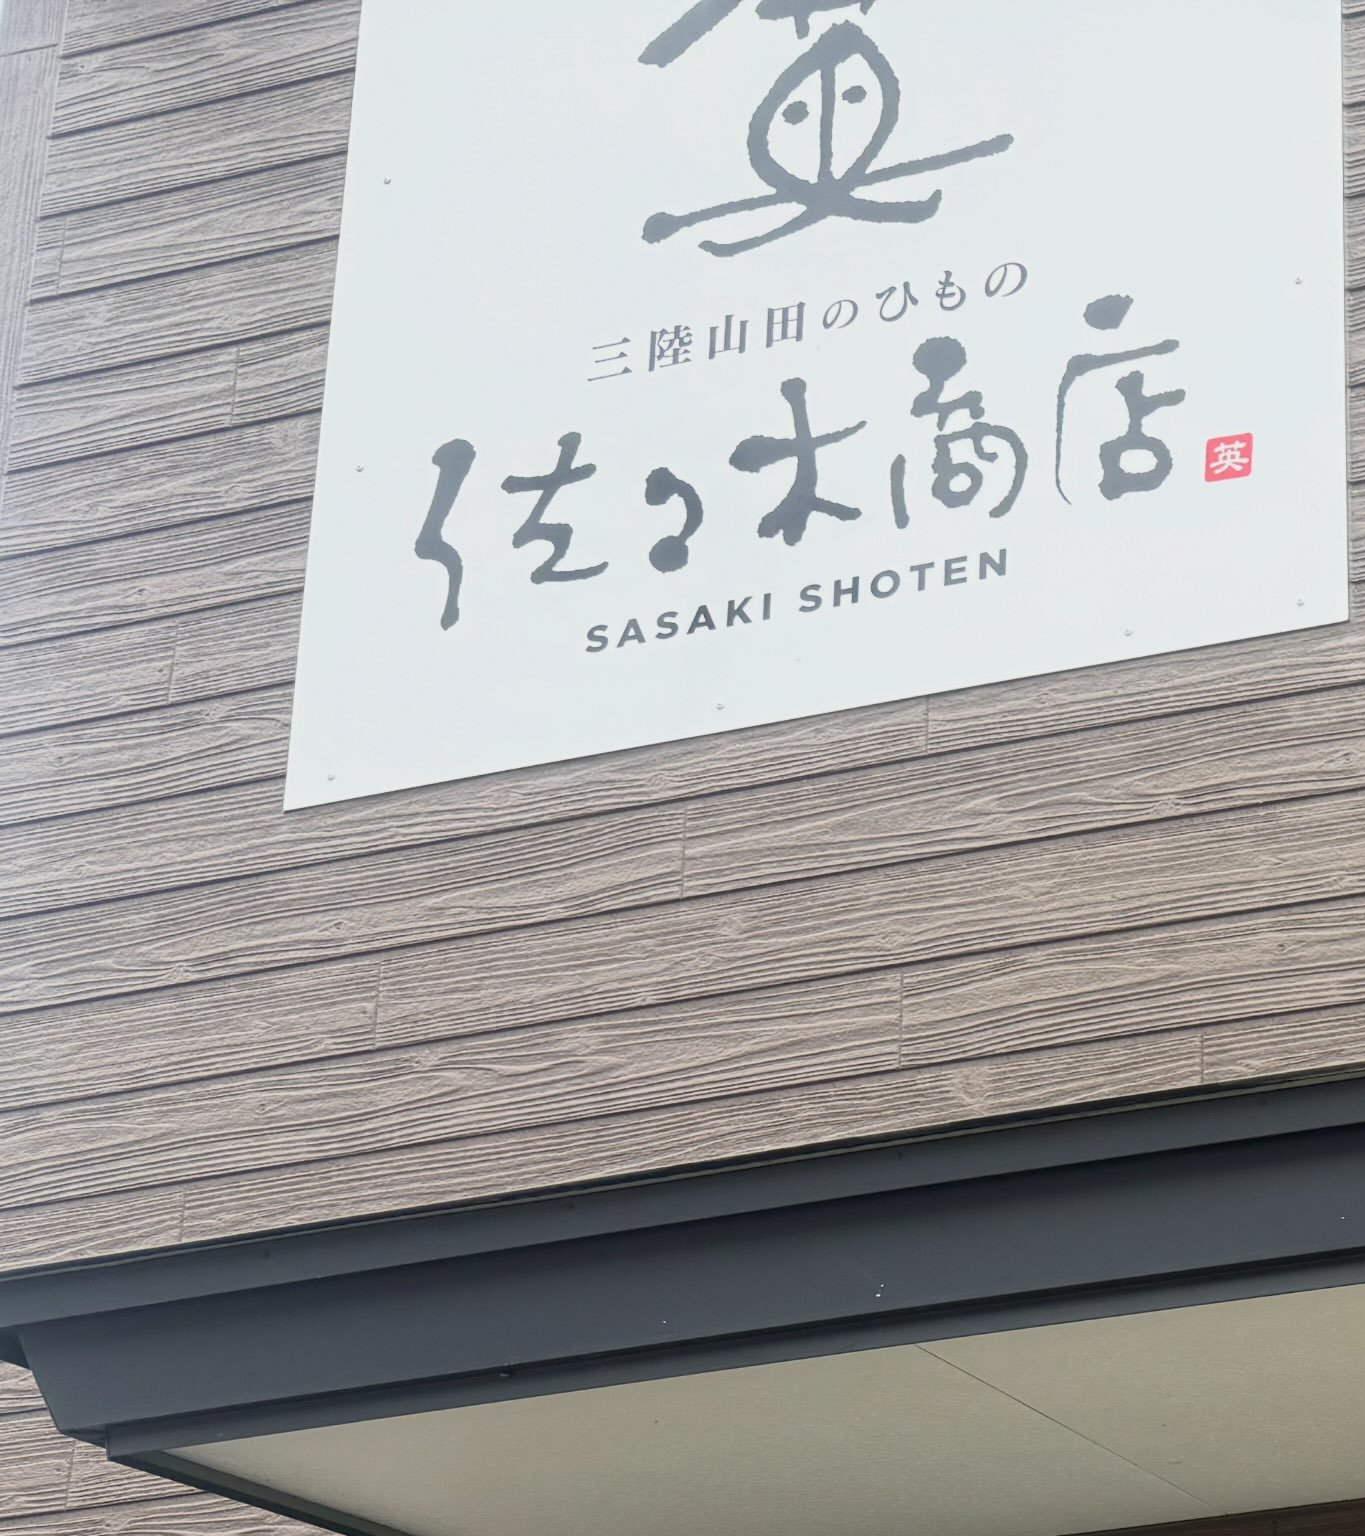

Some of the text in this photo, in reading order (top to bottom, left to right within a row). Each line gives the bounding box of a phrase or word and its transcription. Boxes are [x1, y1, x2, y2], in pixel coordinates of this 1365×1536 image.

[586, 259, 1029, 385] 三陸山田のひもの
[414, 294, 1187, 631] 佐々木商店
[1210, 438, 1250, 476] 英
[584, 547, 1011, 654] SASAKI SHOTEN
